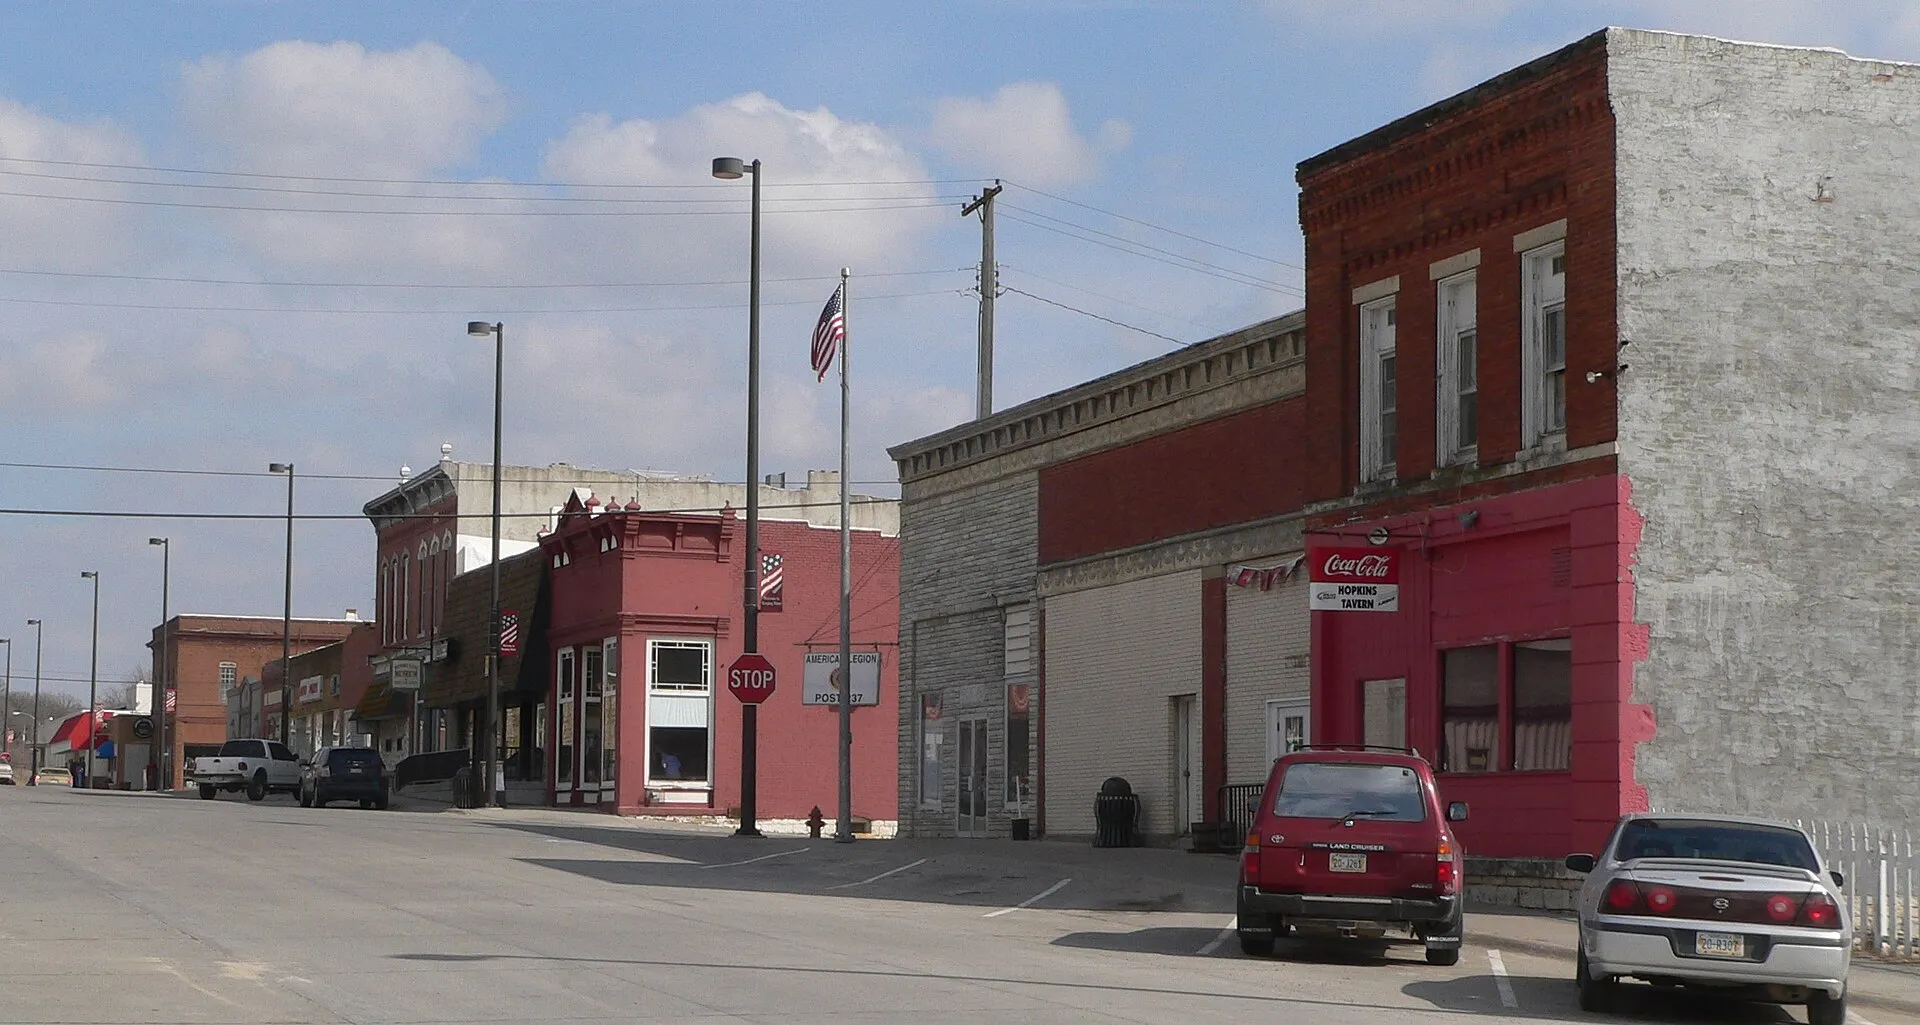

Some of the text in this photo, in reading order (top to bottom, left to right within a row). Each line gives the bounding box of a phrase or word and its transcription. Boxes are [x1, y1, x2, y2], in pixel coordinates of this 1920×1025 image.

[1324, 554, 1391, 577] Coca-Cola
[1338, 586, 1377, 595] HOPKINS
[1341, 600, 1374, 609] TAVERN
[806, 655, 840, 663] AMERICA
[730, 670, 774, 688] STOP
[849, 694, 863, 703] 37
